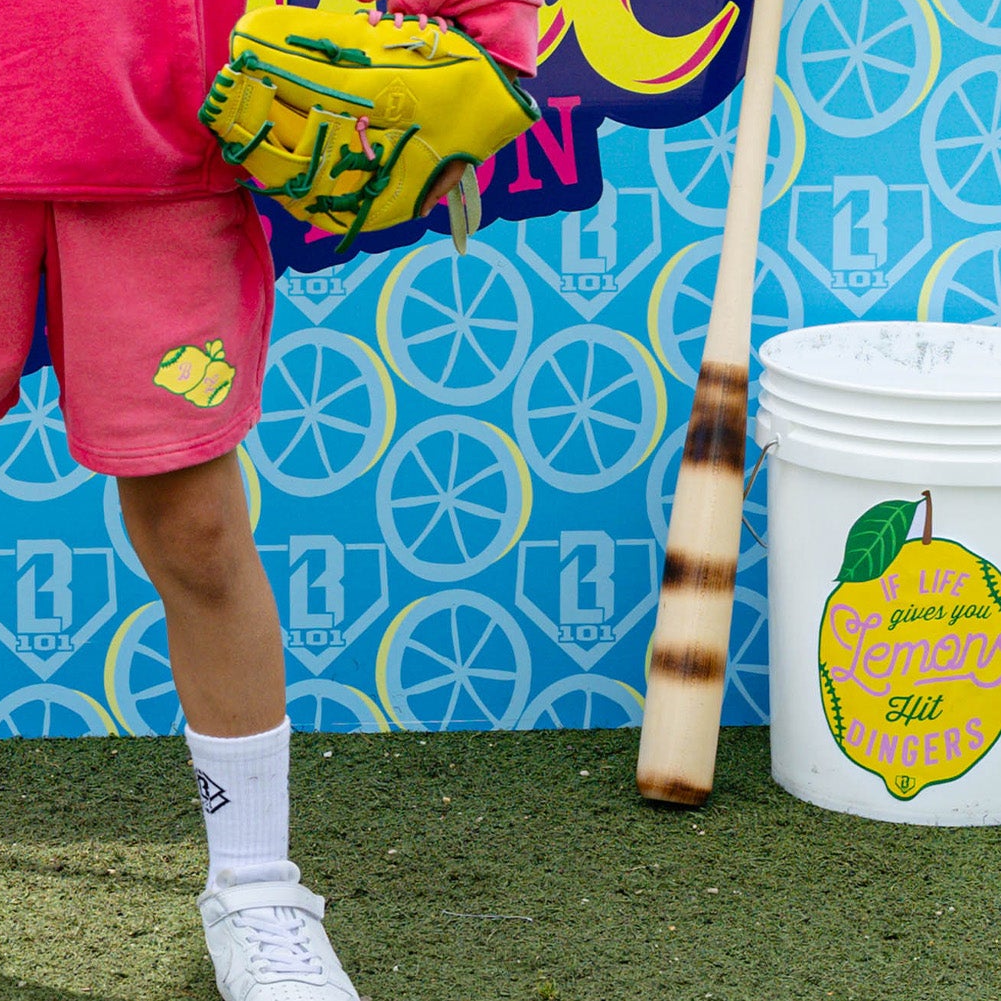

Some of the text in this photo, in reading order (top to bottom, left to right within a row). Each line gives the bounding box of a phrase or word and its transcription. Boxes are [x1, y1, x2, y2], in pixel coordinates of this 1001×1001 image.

[288, 279, 346, 295] 101
[560, 275, 618, 292] 101
[831, 271, 888, 288] 101
[880, 568, 970, 602] IF LIFE
[888, 603, 992, 631] gives you
[288, 629, 346, 646] 101
[558, 625, 616, 642] 101
[16, 635, 74, 652] 101
[885, 694, 944, 727] Hit
[845, 717, 985, 768] DINGERS
